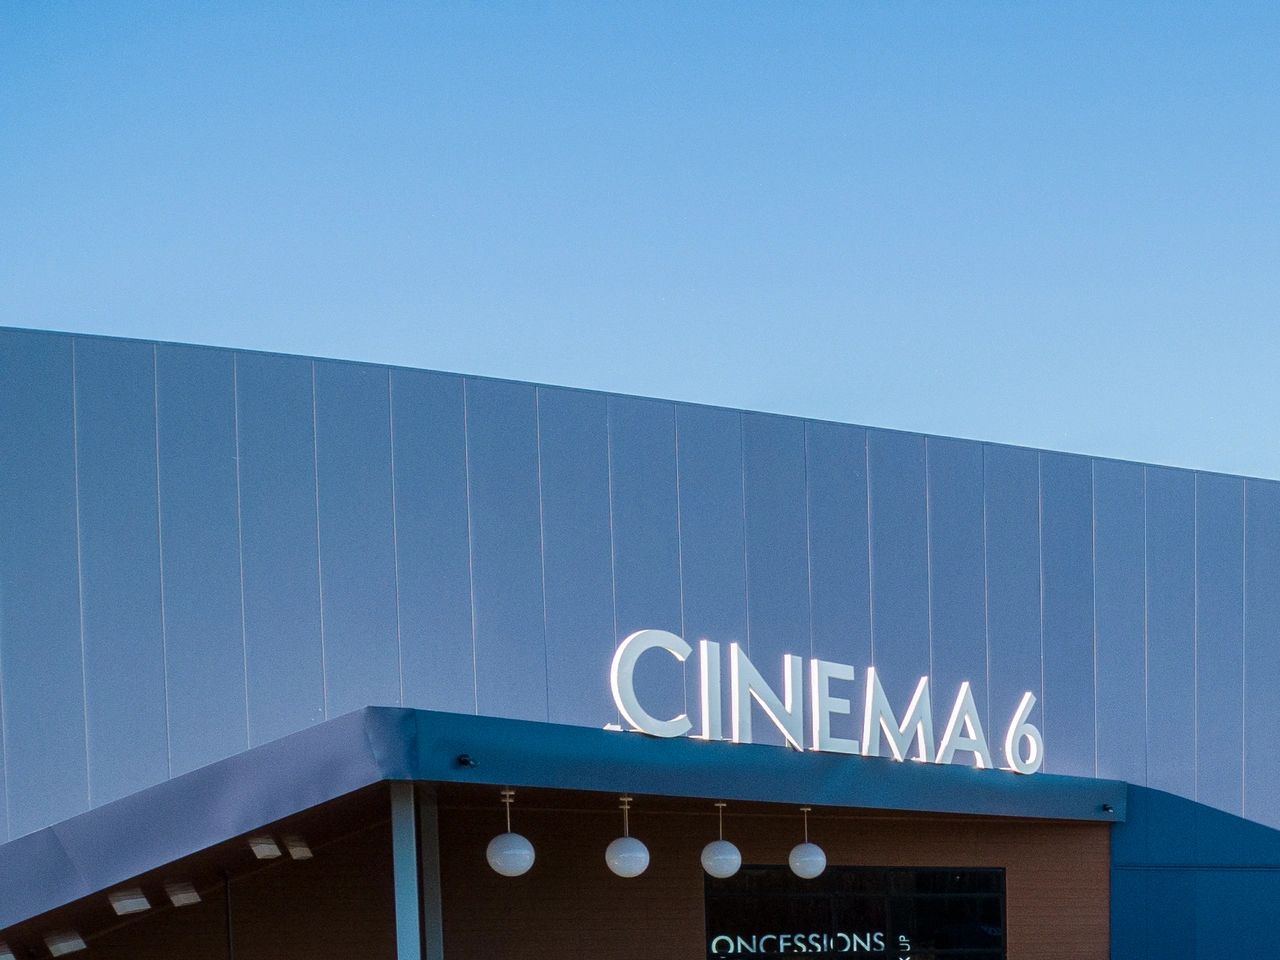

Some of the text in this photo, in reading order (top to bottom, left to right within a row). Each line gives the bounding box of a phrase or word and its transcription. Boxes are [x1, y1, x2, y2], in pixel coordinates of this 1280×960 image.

[610, 629, 1044, 775] CINEMA 6
[711, 932, 885, 955] ONCESSIONS
[898, 935, 911, 952] UP
